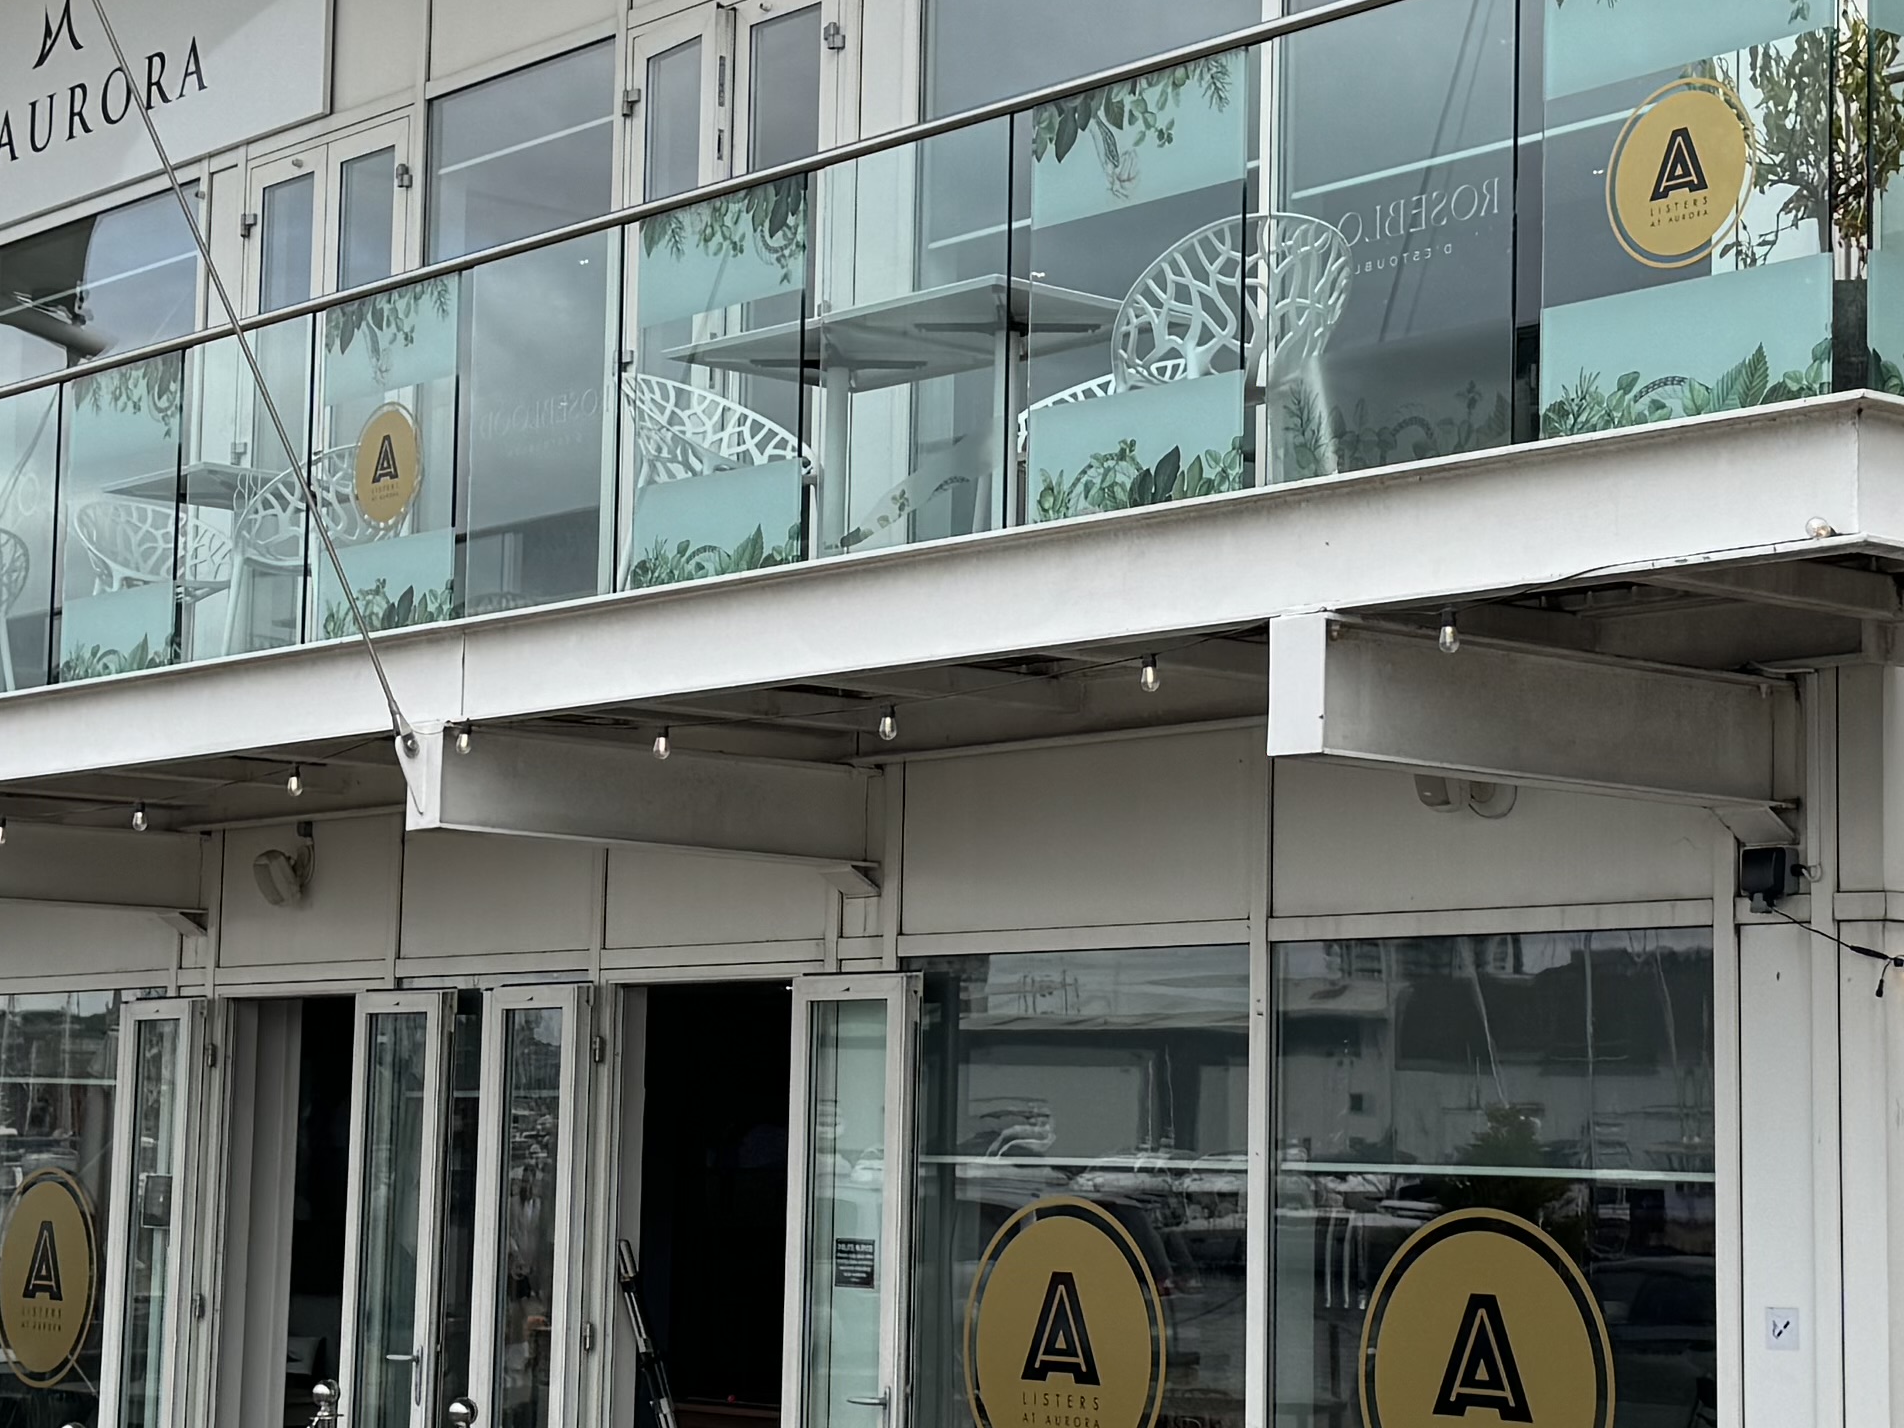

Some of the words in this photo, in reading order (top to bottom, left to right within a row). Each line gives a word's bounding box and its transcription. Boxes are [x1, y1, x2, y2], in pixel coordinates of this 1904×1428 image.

[1649, 126, 1709, 202] A
[1650, 196, 1708, 217] LISTERS
[371, 434, 399, 484] A
[22, 1220, 63, 1301] A
[1021, 1271, 1101, 1386] A
[1432, 1293, 1533, 1424] A
[1022, 1391, 1100, 1411] LISTERS
[1022, 1412, 1036, 1424] AT
